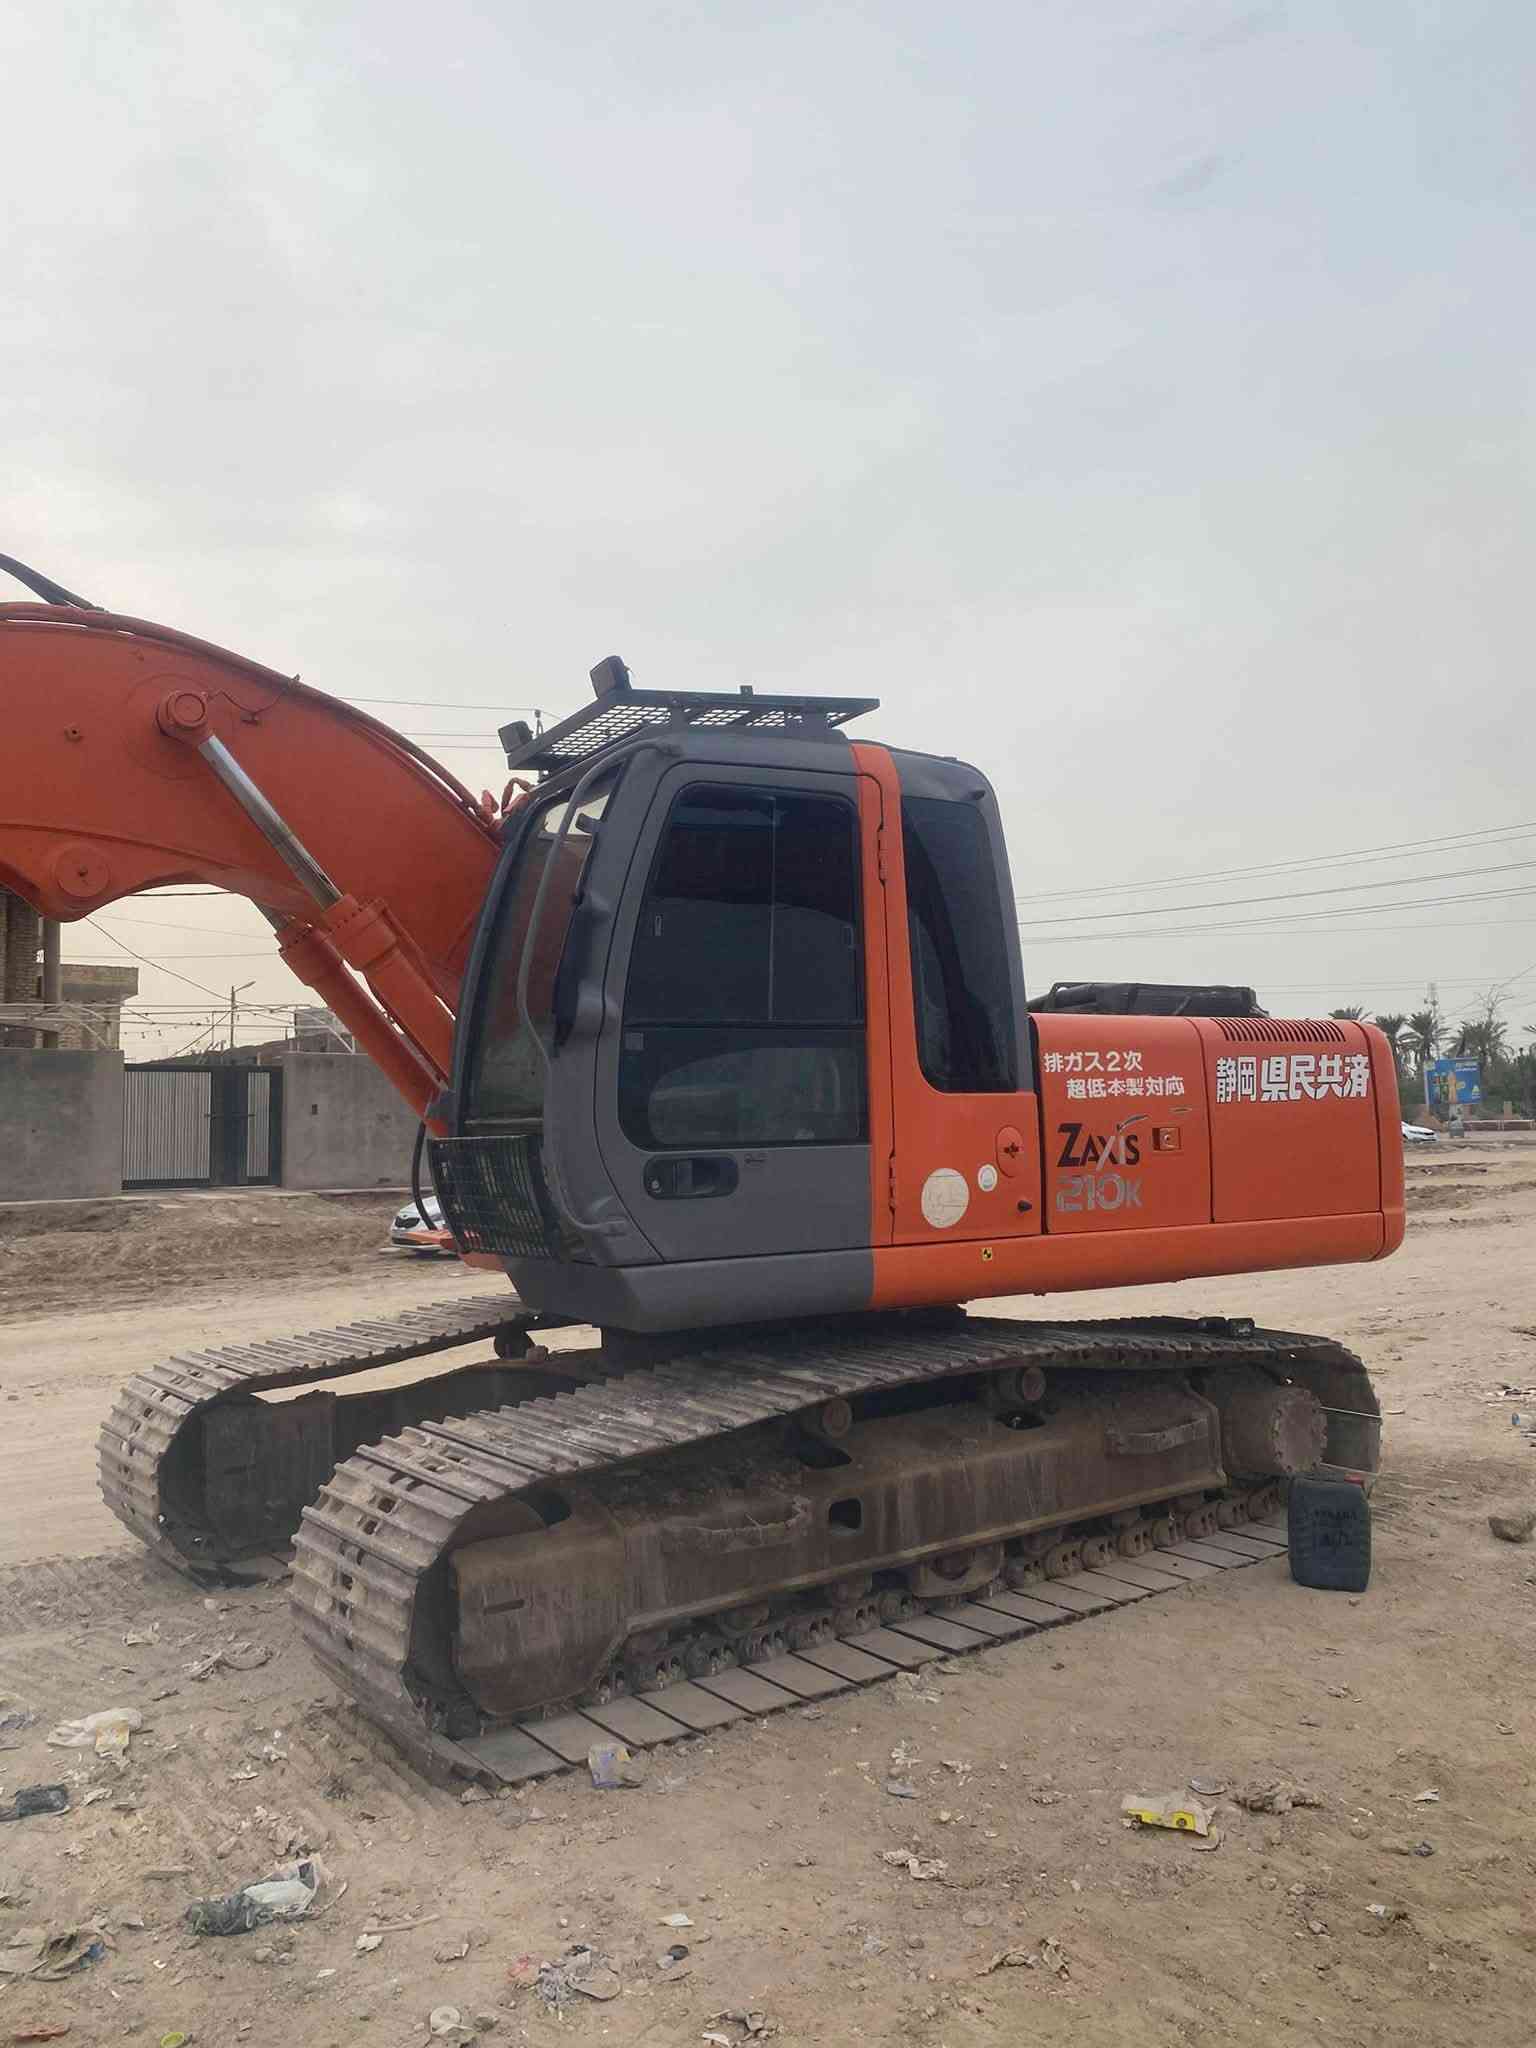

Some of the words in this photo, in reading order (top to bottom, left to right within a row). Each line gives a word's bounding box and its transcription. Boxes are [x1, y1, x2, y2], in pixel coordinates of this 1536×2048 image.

[1216, 1053, 1371, 1103] 静岡県民共済
[1056, 1121, 1141, 1171] ZAXIS
[1055, 1173, 1143, 1212] 210K
